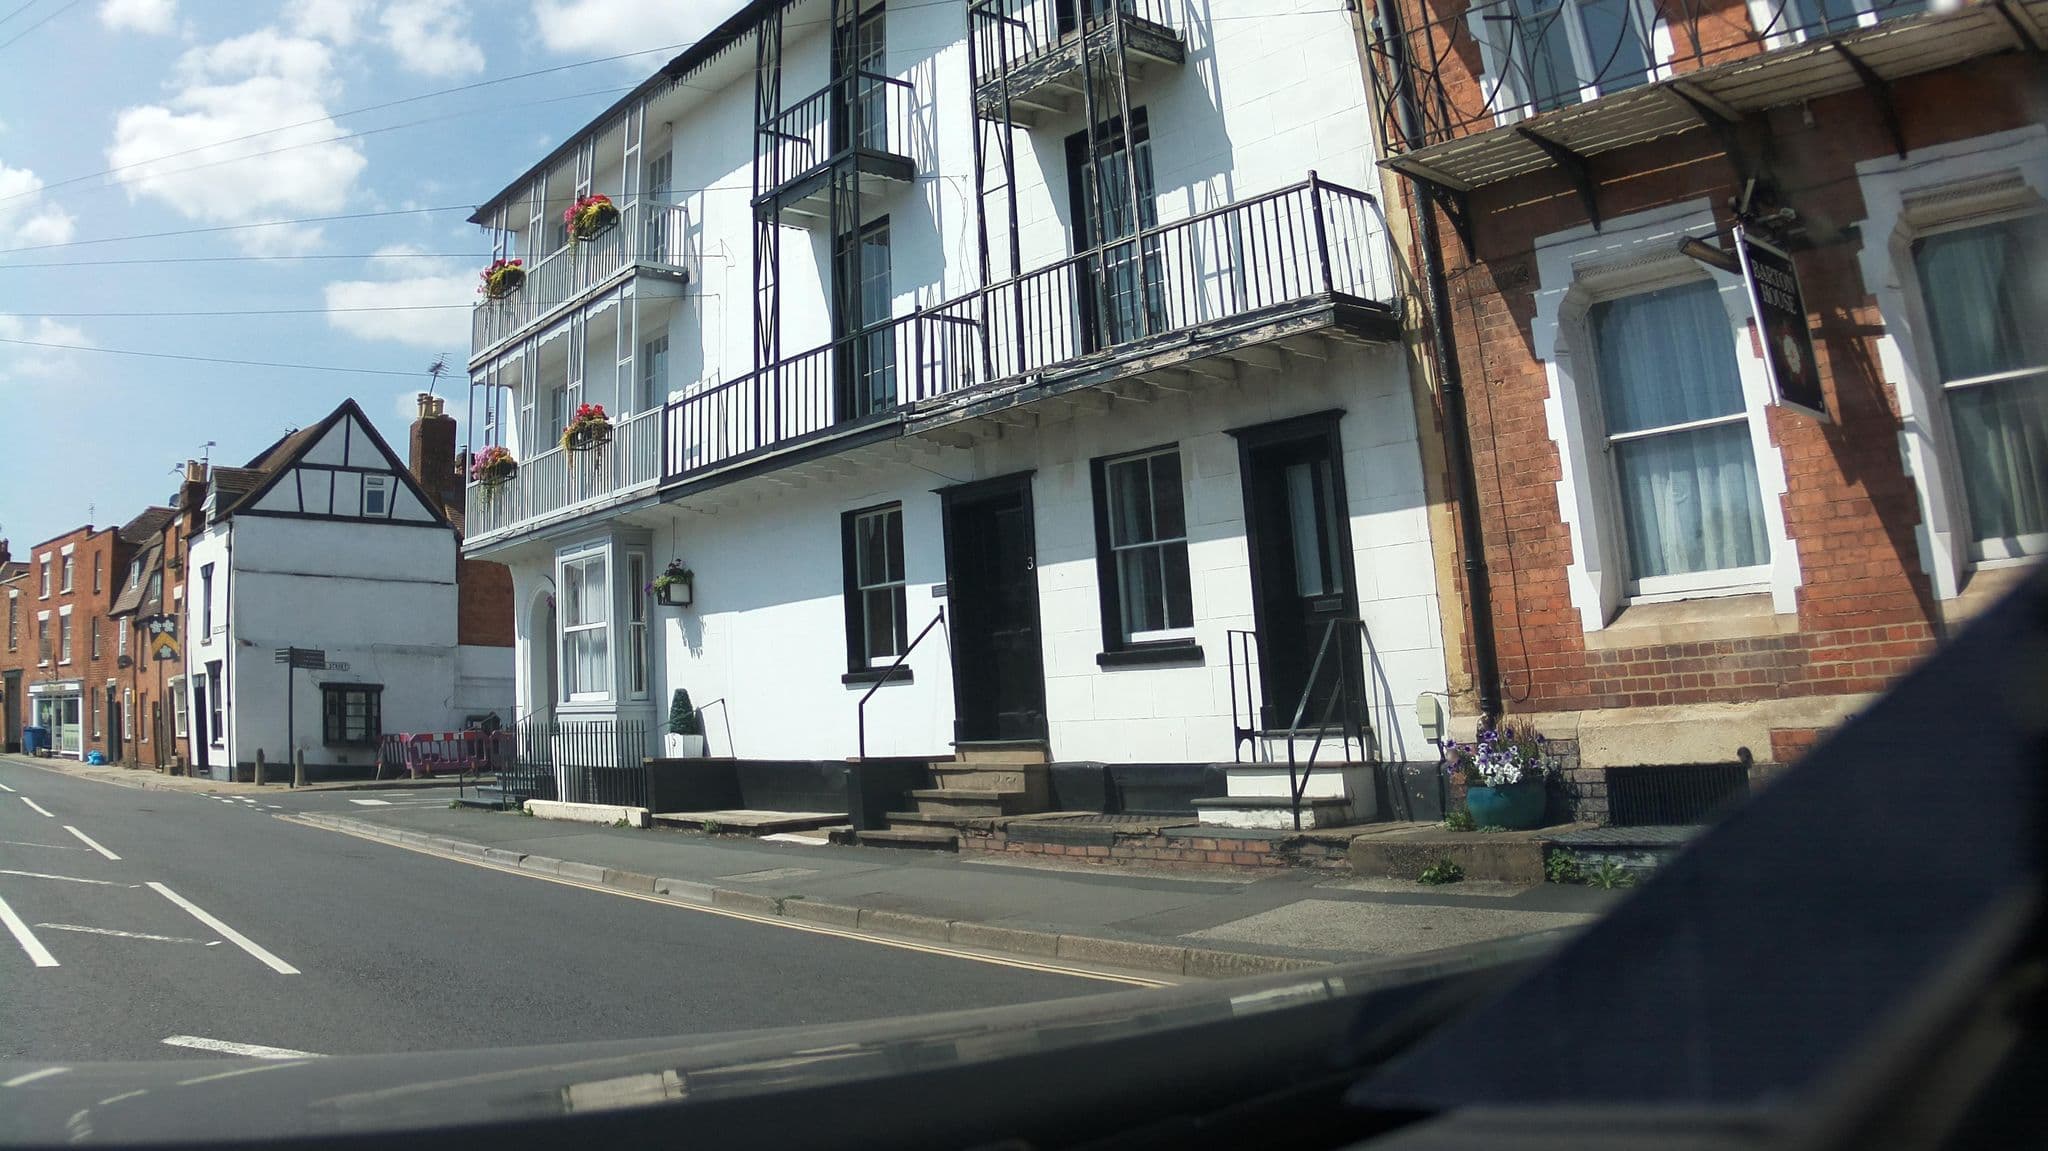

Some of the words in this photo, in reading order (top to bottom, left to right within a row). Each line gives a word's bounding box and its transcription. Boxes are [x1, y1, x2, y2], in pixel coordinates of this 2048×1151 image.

[1751, 259, 1795, 294] BARTON
[1760, 283, 1797, 315] HOUSE
[1027, 556, 1034, 570] 3
